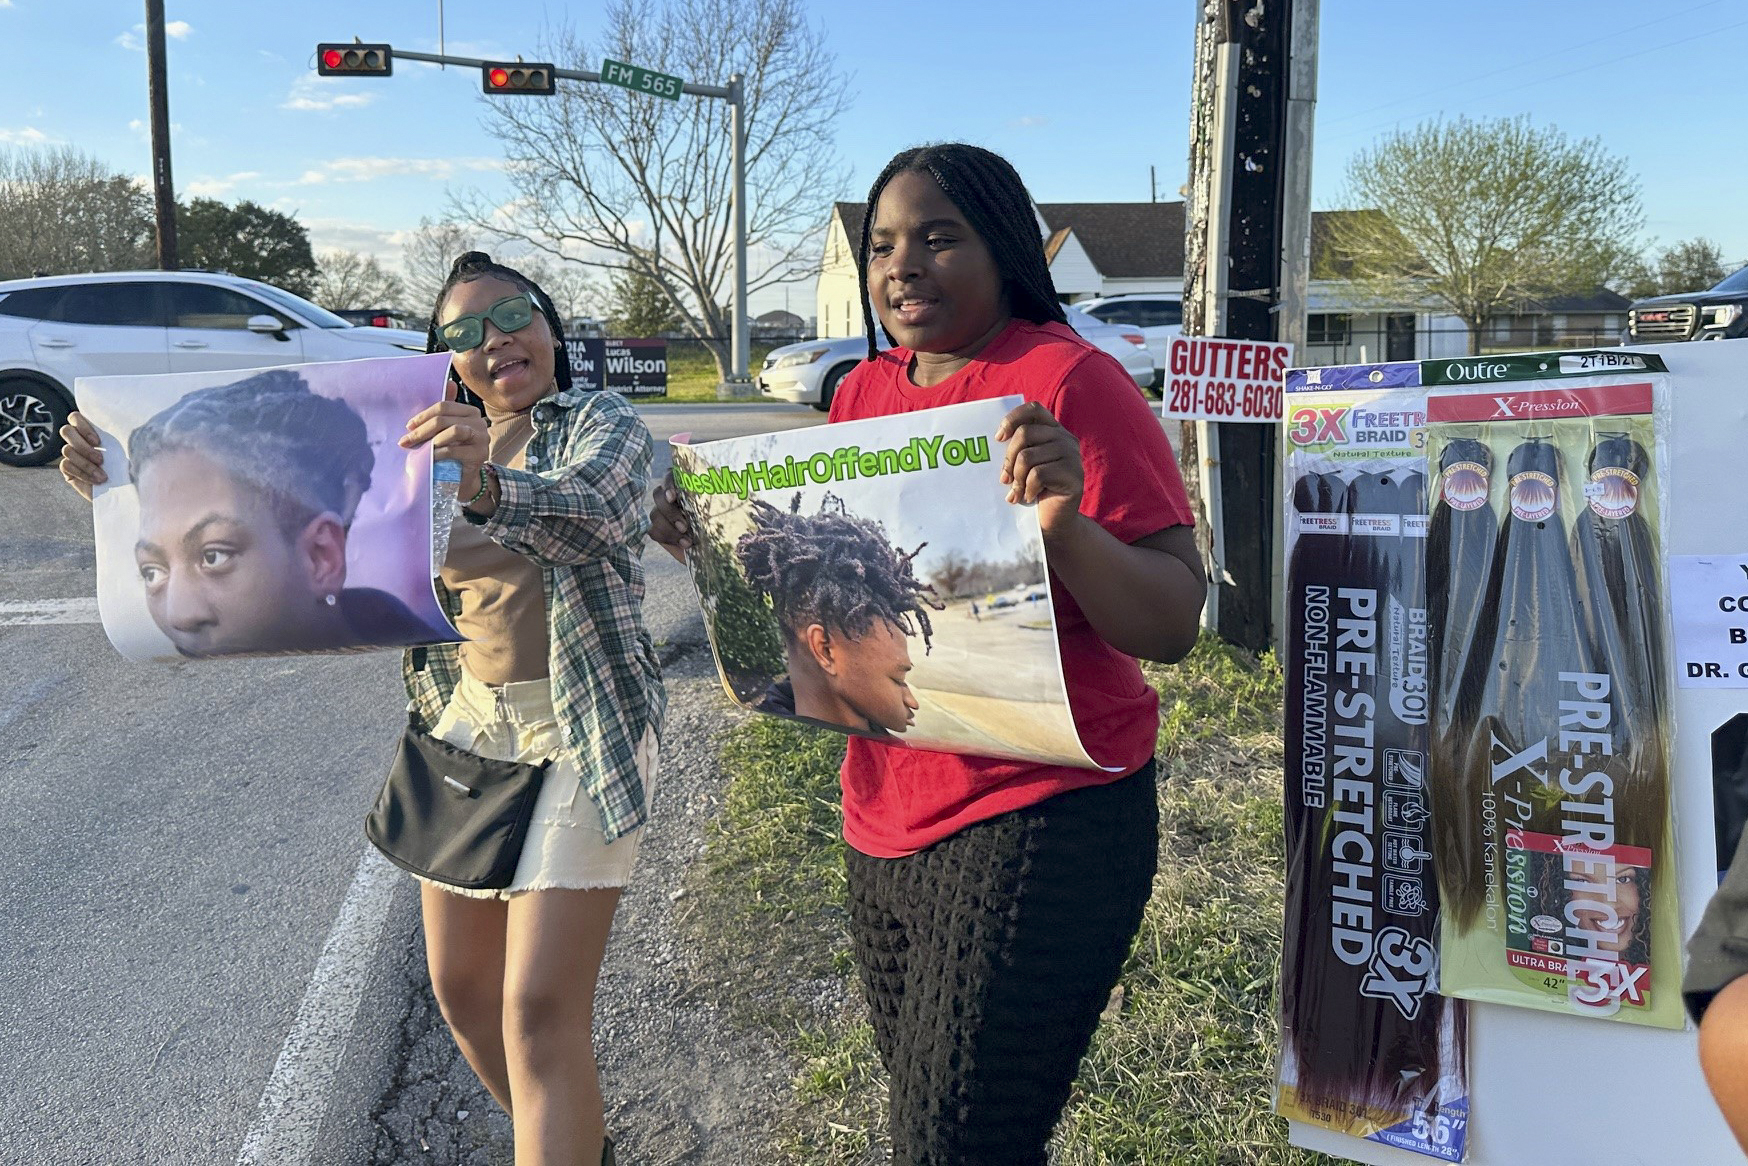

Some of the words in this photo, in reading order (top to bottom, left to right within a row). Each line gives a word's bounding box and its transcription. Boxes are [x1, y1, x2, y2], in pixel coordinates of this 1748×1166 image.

[607, 64, 634, 85] FM
[641, 73, 676, 96] 565
[605, 348, 631, 357] Lucas
[1170, 340, 1288, 382] GUTTERS
[606, 356, 666, 374] Wilson
[1446, 362, 1508, 381] Outre
[1169, 379, 1283, 419] 281-683-6030
[1492, 396, 1579, 417] X-Pression
[1290, 408, 1349, 444] 3X
[1356, 430, 1406, 443] BRAID
[1333, 450, 1370, 458] Natural
[1373, 450, 1412, 458] Texture
[1445, 463, 1488, 478] PRE-STRETCHED
[1511, 473, 1555, 487] PRE-STRETCHED
[1592, 468, 1640, 485] PRE-STRETCHED
[1449, 497, 1484, 508] PRE-LAYERED
[1593, 503, 1631, 517] PRE-LAYERED
[1299, 516, 1337, 525] FREETRESS
[1351, 516, 1391, 527] FREETRESS
[1514, 507, 1550, 519] PRE-LAYERED
[1392, 607, 1400, 646] Natural
[1408, 607, 1427, 677] BRAID
[1392, 648, 1400, 688] Texture
[1686, 662, 1730, 678] DR.
[1303, 585, 1330, 809] NON-FLAMMABLE
[1402, 680, 1427, 719] 301
[1332, 587, 1378, 966] PRE-STRETCHED
[1482, 791, 1497, 836] 100%
[1490, 729, 1548, 935] X-Pression
[1558, 671, 1621, 1017] PRE-STRETCHED
[1484, 842, 1499, 930] Kanekalon
[1512, 954, 1545, 969] ULTRA
[1362, 928, 1432, 1018] 3X
[1543, 977, 1565, 989] 42"
